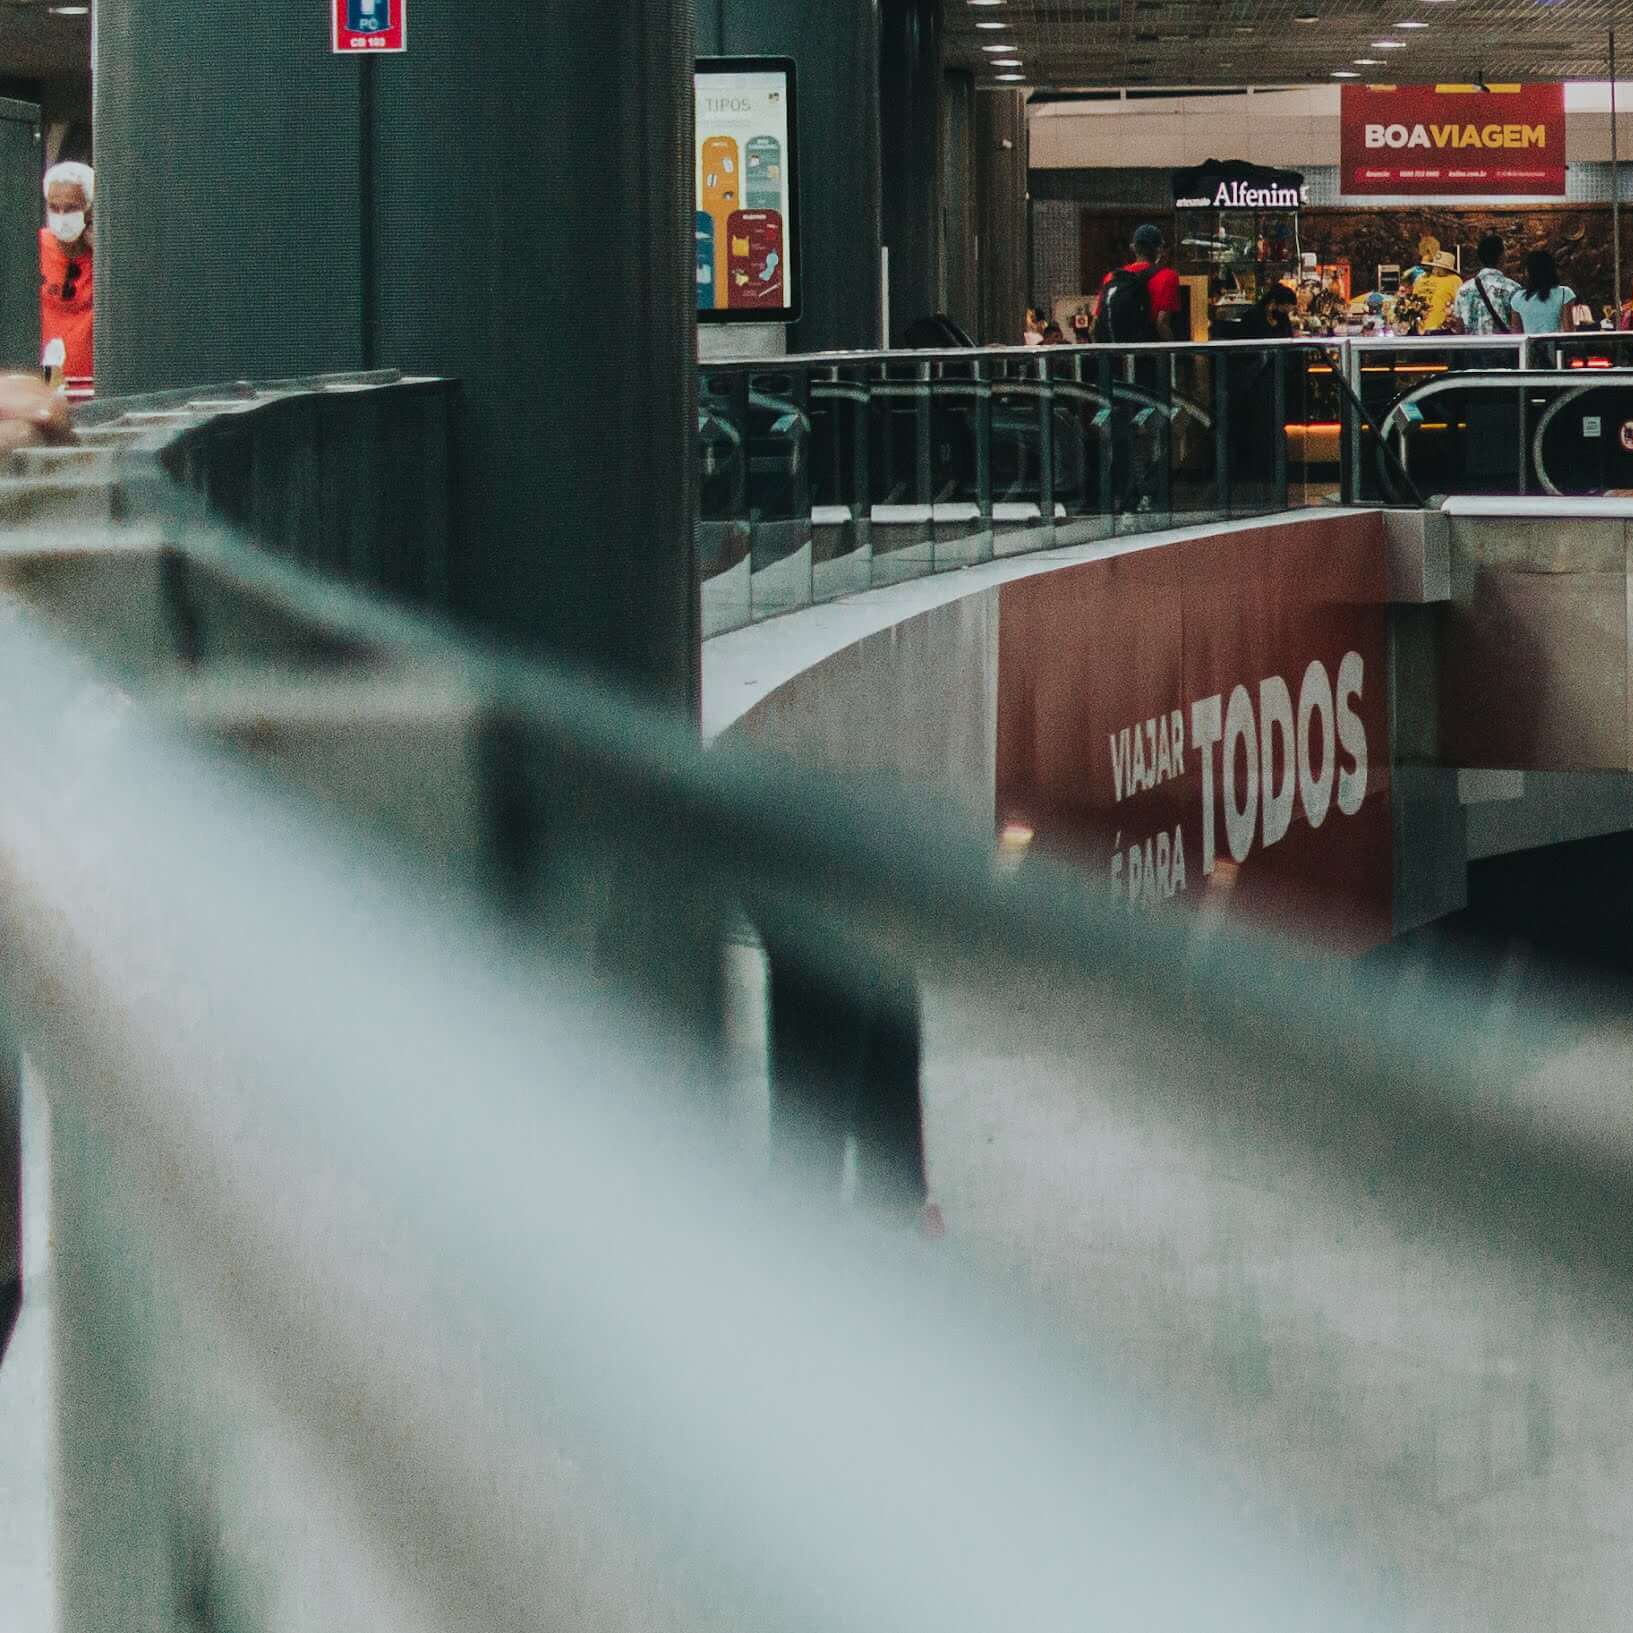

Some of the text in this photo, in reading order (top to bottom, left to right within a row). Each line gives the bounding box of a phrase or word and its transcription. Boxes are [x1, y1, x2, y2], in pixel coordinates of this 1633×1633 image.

[1213, 181, 1299, 207] Alfenim
[1110, 709, 1185, 802] VIAJAR
[1191, 650, 1369, 876] TODOS
[1129, 824, 1186, 905] PARA
